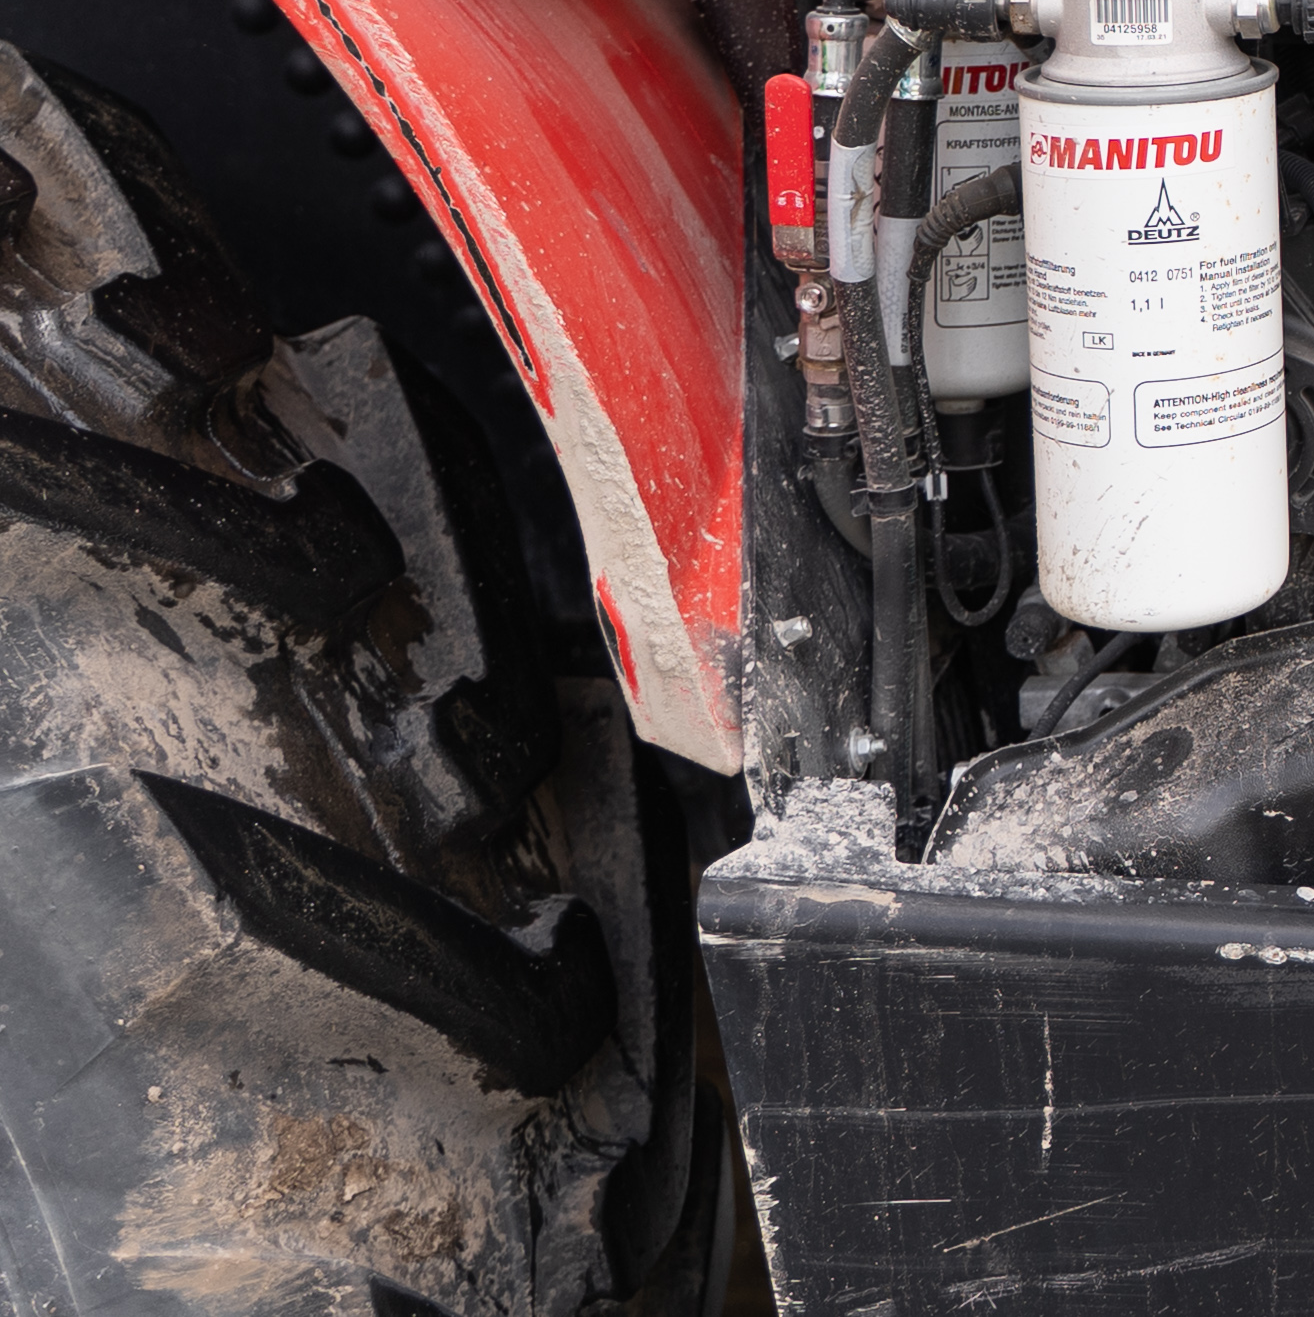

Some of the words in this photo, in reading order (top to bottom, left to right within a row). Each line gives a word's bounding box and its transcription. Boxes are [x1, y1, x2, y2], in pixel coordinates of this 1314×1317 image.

[1103, 24, 1158, 34] 04125958
[943, 61, 1030, 95] ITOU
[1050, 129, 1224, 171] MANITOU
[1128, 225, 1200, 241] DEUTZ
[1200, 260, 1217, 271] For
[1220, 255, 1237, 267] fuel
[1129, 270, 1158, 283] 0412
[1167, 267, 1194, 281] 0751
[1200, 267, 1233, 282] Manual
[1211, 281, 1230, 292] Apply
[1211, 290, 1236, 302] Tighten
[1131, 298, 1151, 312] 1,1
[1212, 302, 1228, 312] Vent
[1212, 311, 1234, 322] Check
[1092, 335, 1107, 346] LK
[1153, 390, 1231, 409] ATTENTION-High
[1154, 412, 1177, 421] Keep
[1180, 404, 1227, 419] component
[1154, 424, 1172, 433] See
[1175, 418, 1215, 431] Technical
[1218, 411, 1247, 424] Circular
